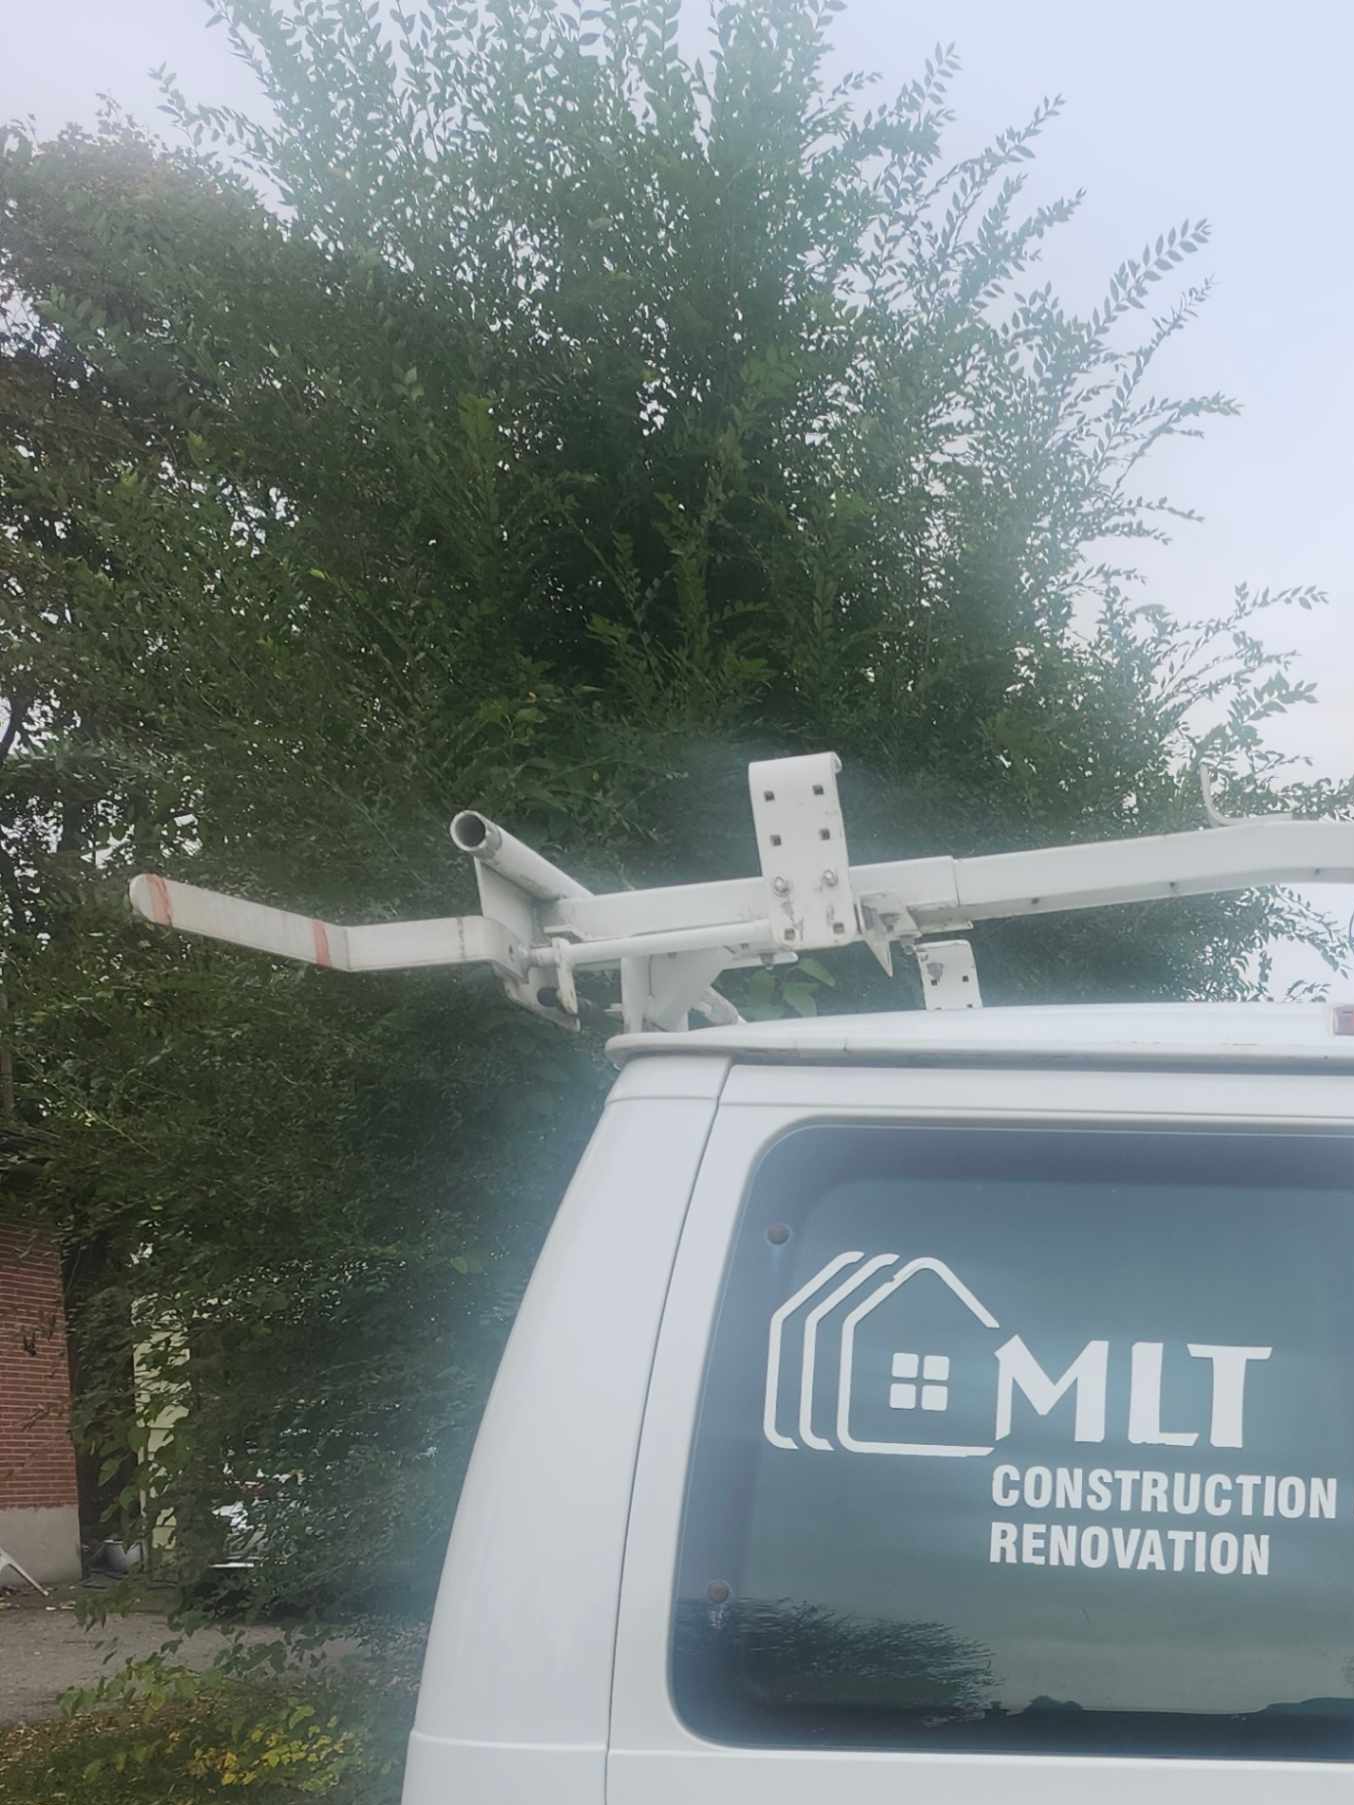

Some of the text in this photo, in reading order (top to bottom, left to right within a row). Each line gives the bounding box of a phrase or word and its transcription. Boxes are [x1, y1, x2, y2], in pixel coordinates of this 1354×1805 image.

[994, 1334, 1272, 1448] MLT
[992, 1464, 1337, 1519] CONSTRUCTION
[990, 1522, 1270, 1575] RENOVATION
